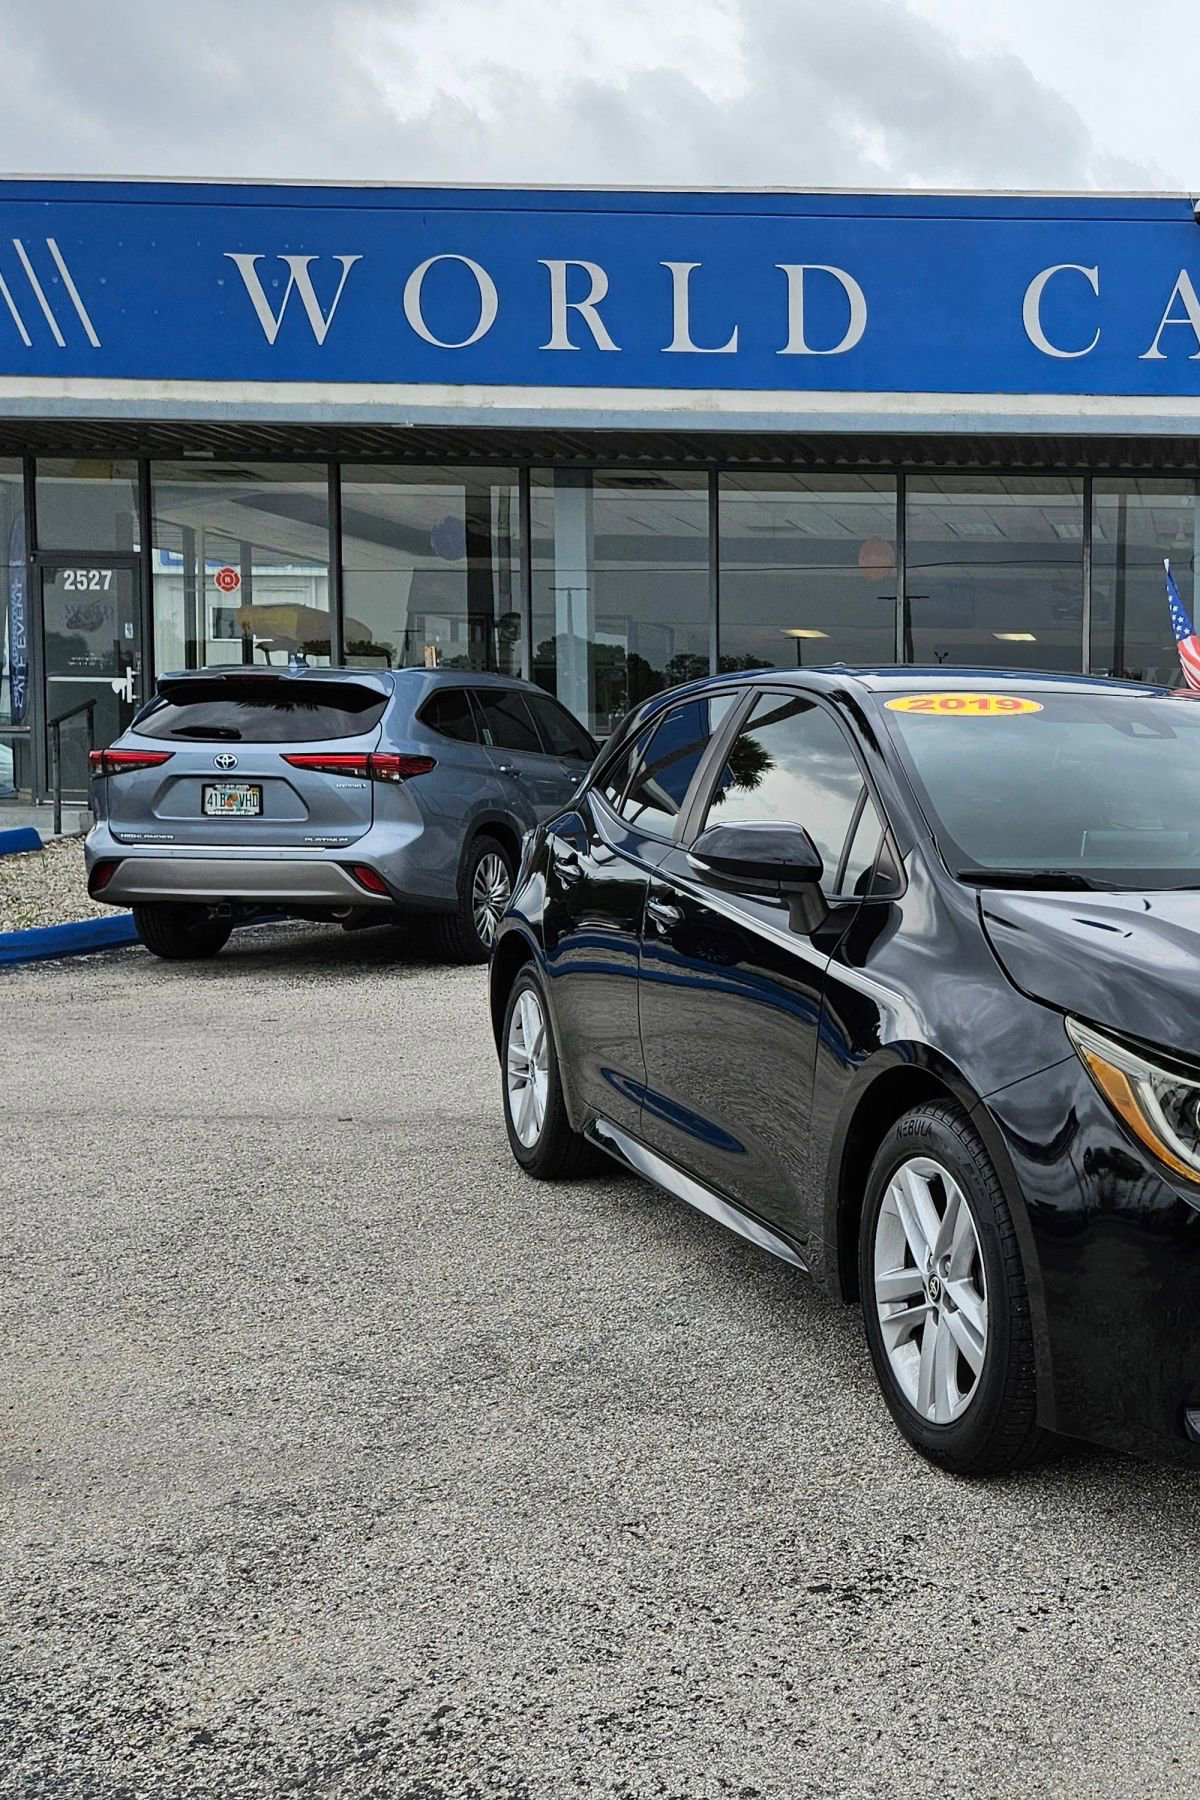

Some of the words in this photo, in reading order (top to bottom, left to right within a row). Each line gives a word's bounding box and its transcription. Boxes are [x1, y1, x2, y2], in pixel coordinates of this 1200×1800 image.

[223, 253, 868, 355] WORLD
[63, 569, 112, 590] 2527
[908, 698, 1022, 711] 2019
[239, 792, 259, 808] VHD
